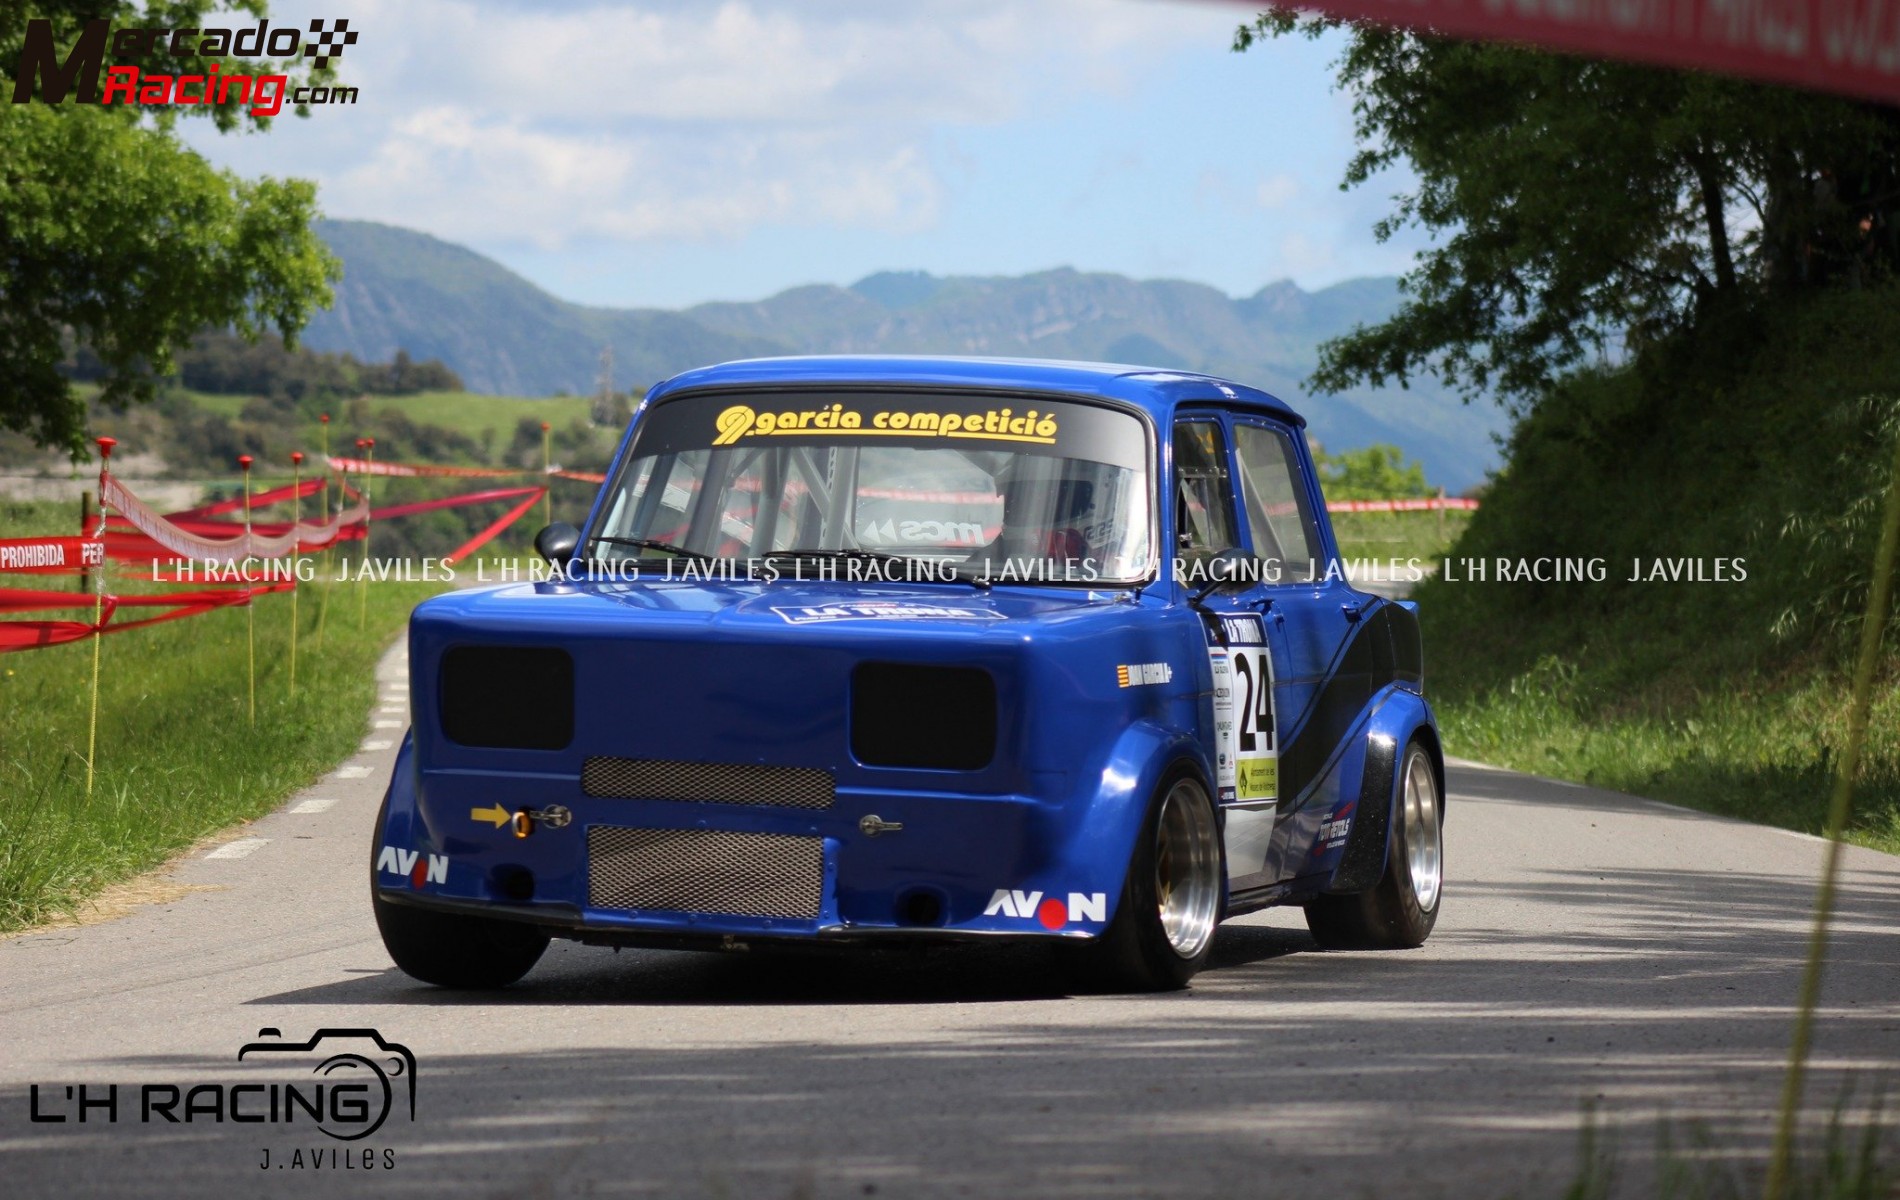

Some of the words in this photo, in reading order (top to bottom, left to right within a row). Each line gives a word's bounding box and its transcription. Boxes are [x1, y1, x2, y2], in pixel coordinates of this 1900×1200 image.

[873, 408, 1058, 437] competició
[1, 543, 65, 568] PROHIBIDA
[1234, 652, 1274, 752] 24
[376, 845, 449, 890] AVON
[983, 888, 1106, 931] AVON
